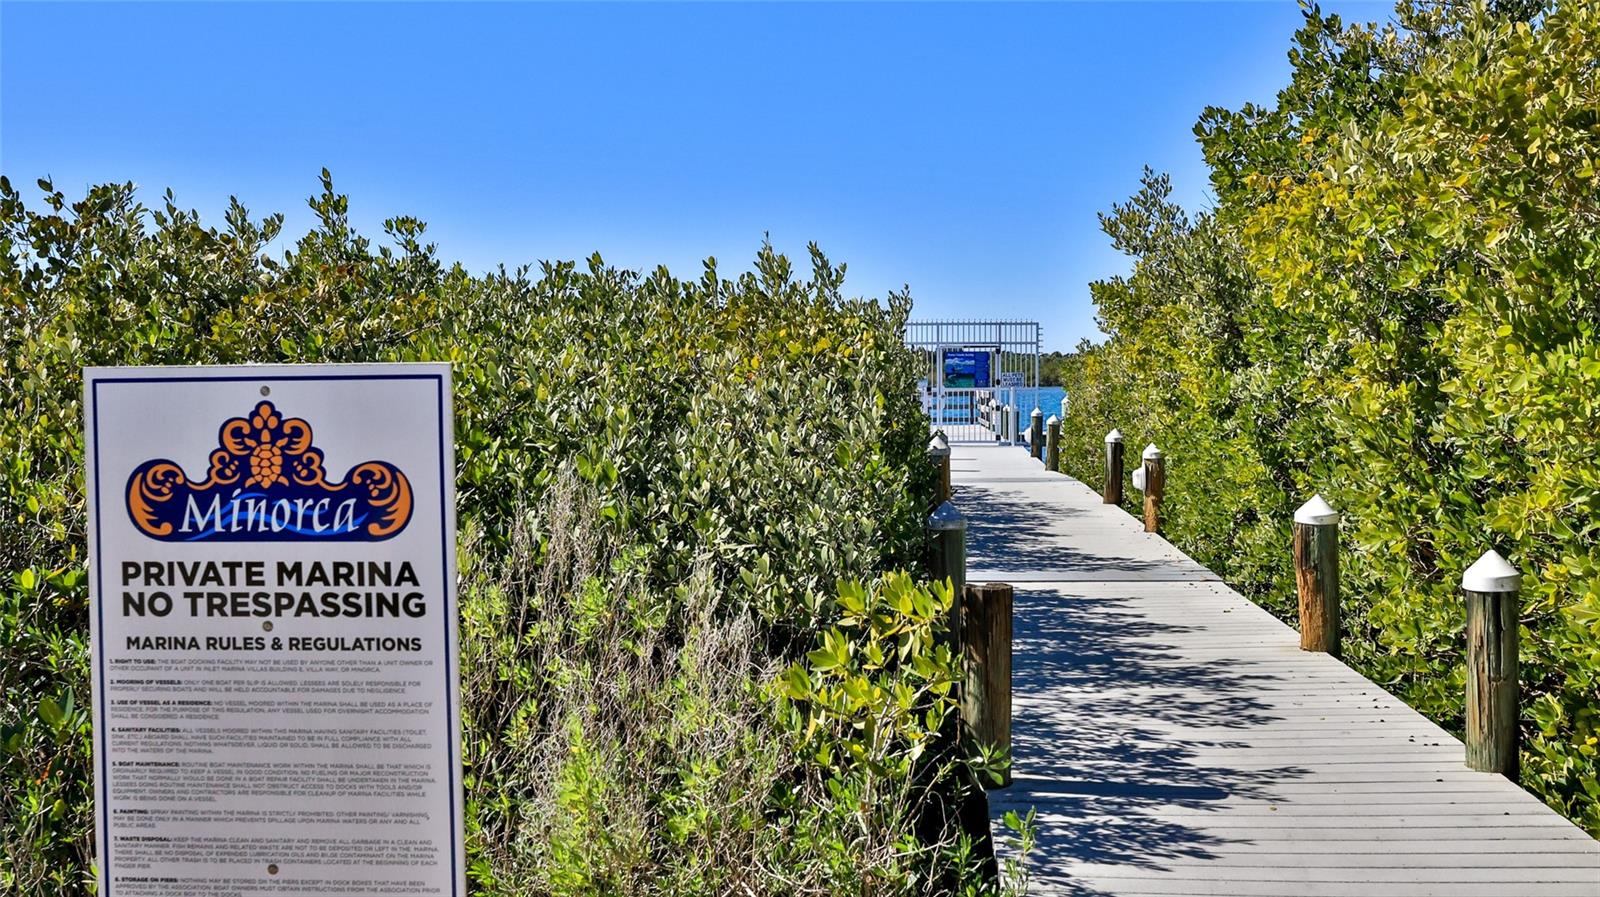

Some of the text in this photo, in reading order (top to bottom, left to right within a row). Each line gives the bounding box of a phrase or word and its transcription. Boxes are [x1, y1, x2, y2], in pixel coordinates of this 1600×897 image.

[179, 488, 360, 533] Minorca
[122, 561, 420, 586] PRIVATE MARINA
[123, 591, 426, 618] NO TRESPASSING
[127, 637, 422, 651] MARINA RULES & REGULATIONS
